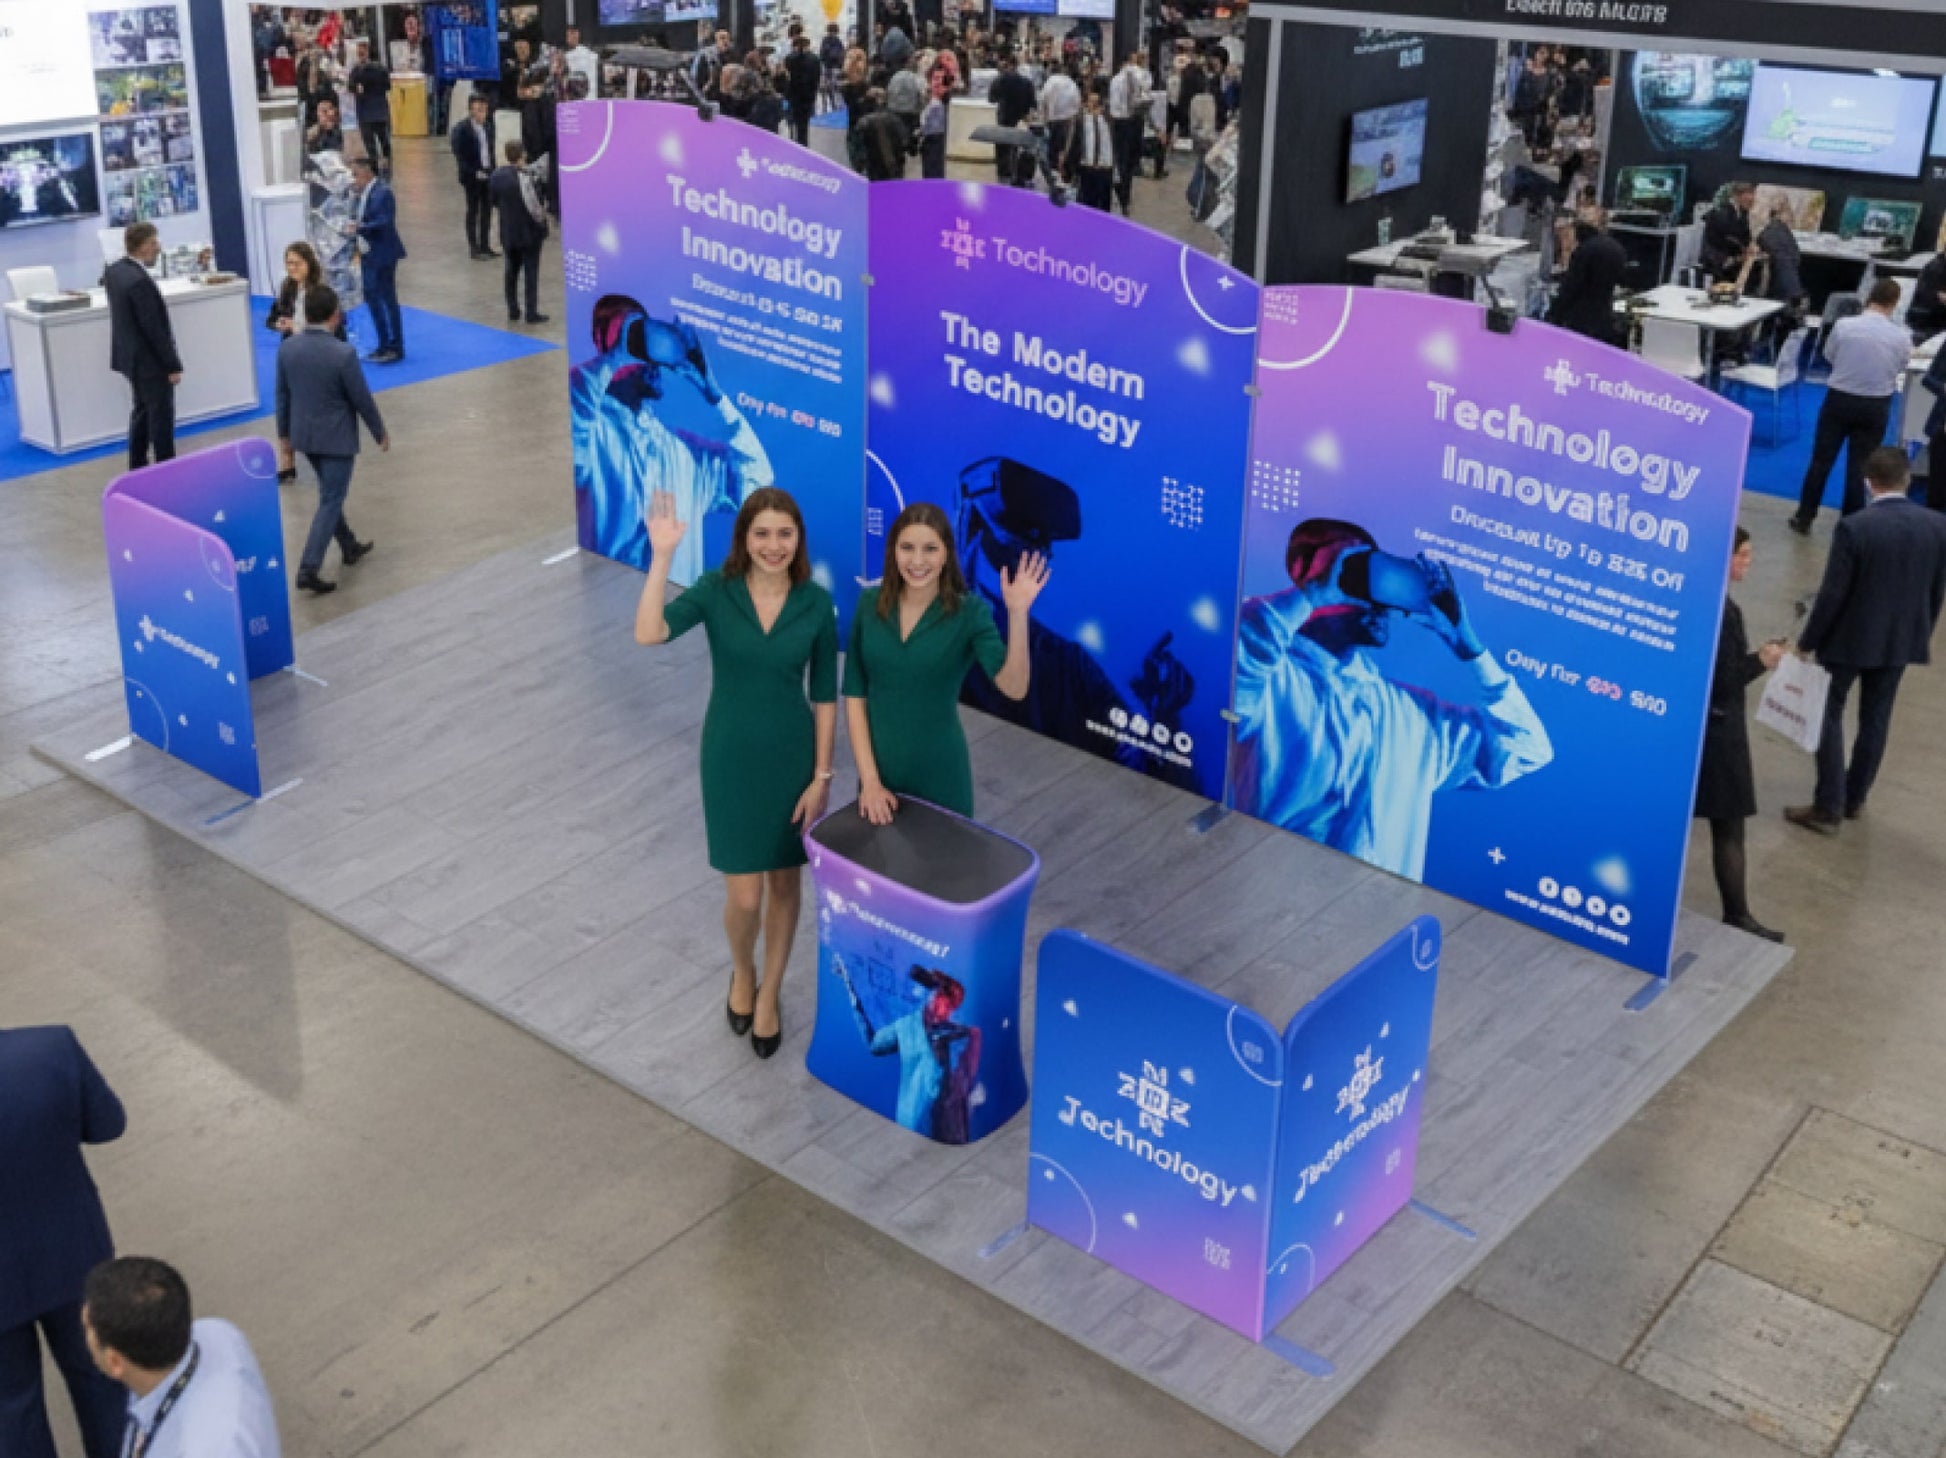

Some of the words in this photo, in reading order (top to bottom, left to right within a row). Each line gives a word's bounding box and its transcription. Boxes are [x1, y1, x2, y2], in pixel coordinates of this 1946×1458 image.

[666, 173, 842, 259] Technology
[681, 226, 843, 301] Innovation
[940, 310, 1000, 355] The
[1013, 331, 1145, 400] Modern
[944, 353, 1141, 448] Technology
[1426, 379, 1701, 501] Technology
[1441, 444, 1689, 552] Innovation
